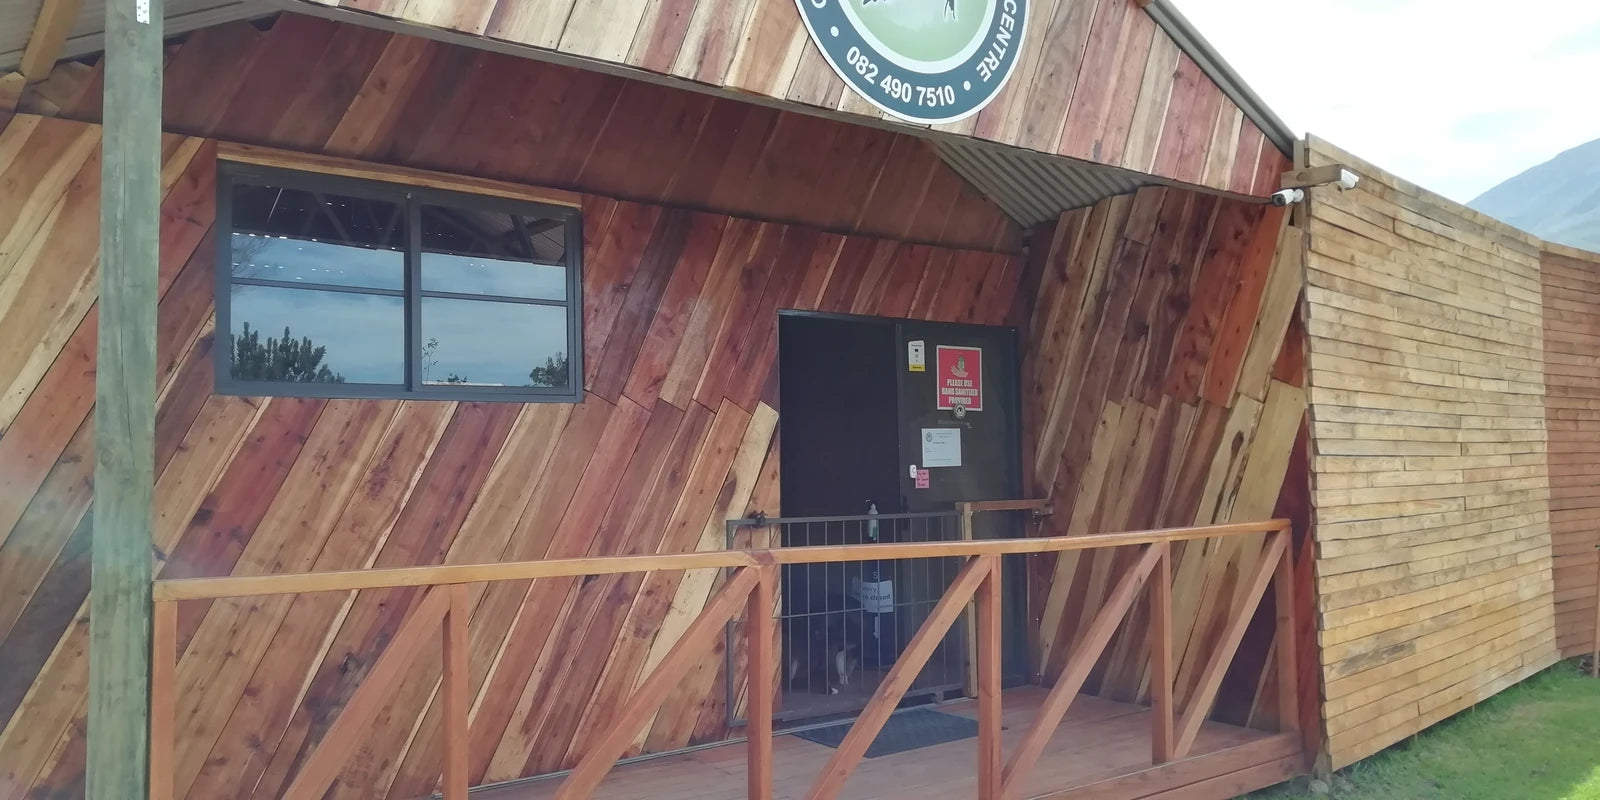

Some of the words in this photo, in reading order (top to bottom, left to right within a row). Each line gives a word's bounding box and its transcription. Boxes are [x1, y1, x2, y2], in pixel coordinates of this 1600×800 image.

[975, 0, 1017, 82] CENTRE
[846, 46, 879, 84] 082
[880, 74, 912, 101] 490
[916, 85, 956, 107] 7510
[941, 387, 954, 395] HAND
[947, 379, 963, 387] PLEASE
[963, 379, 973, 388] USE
